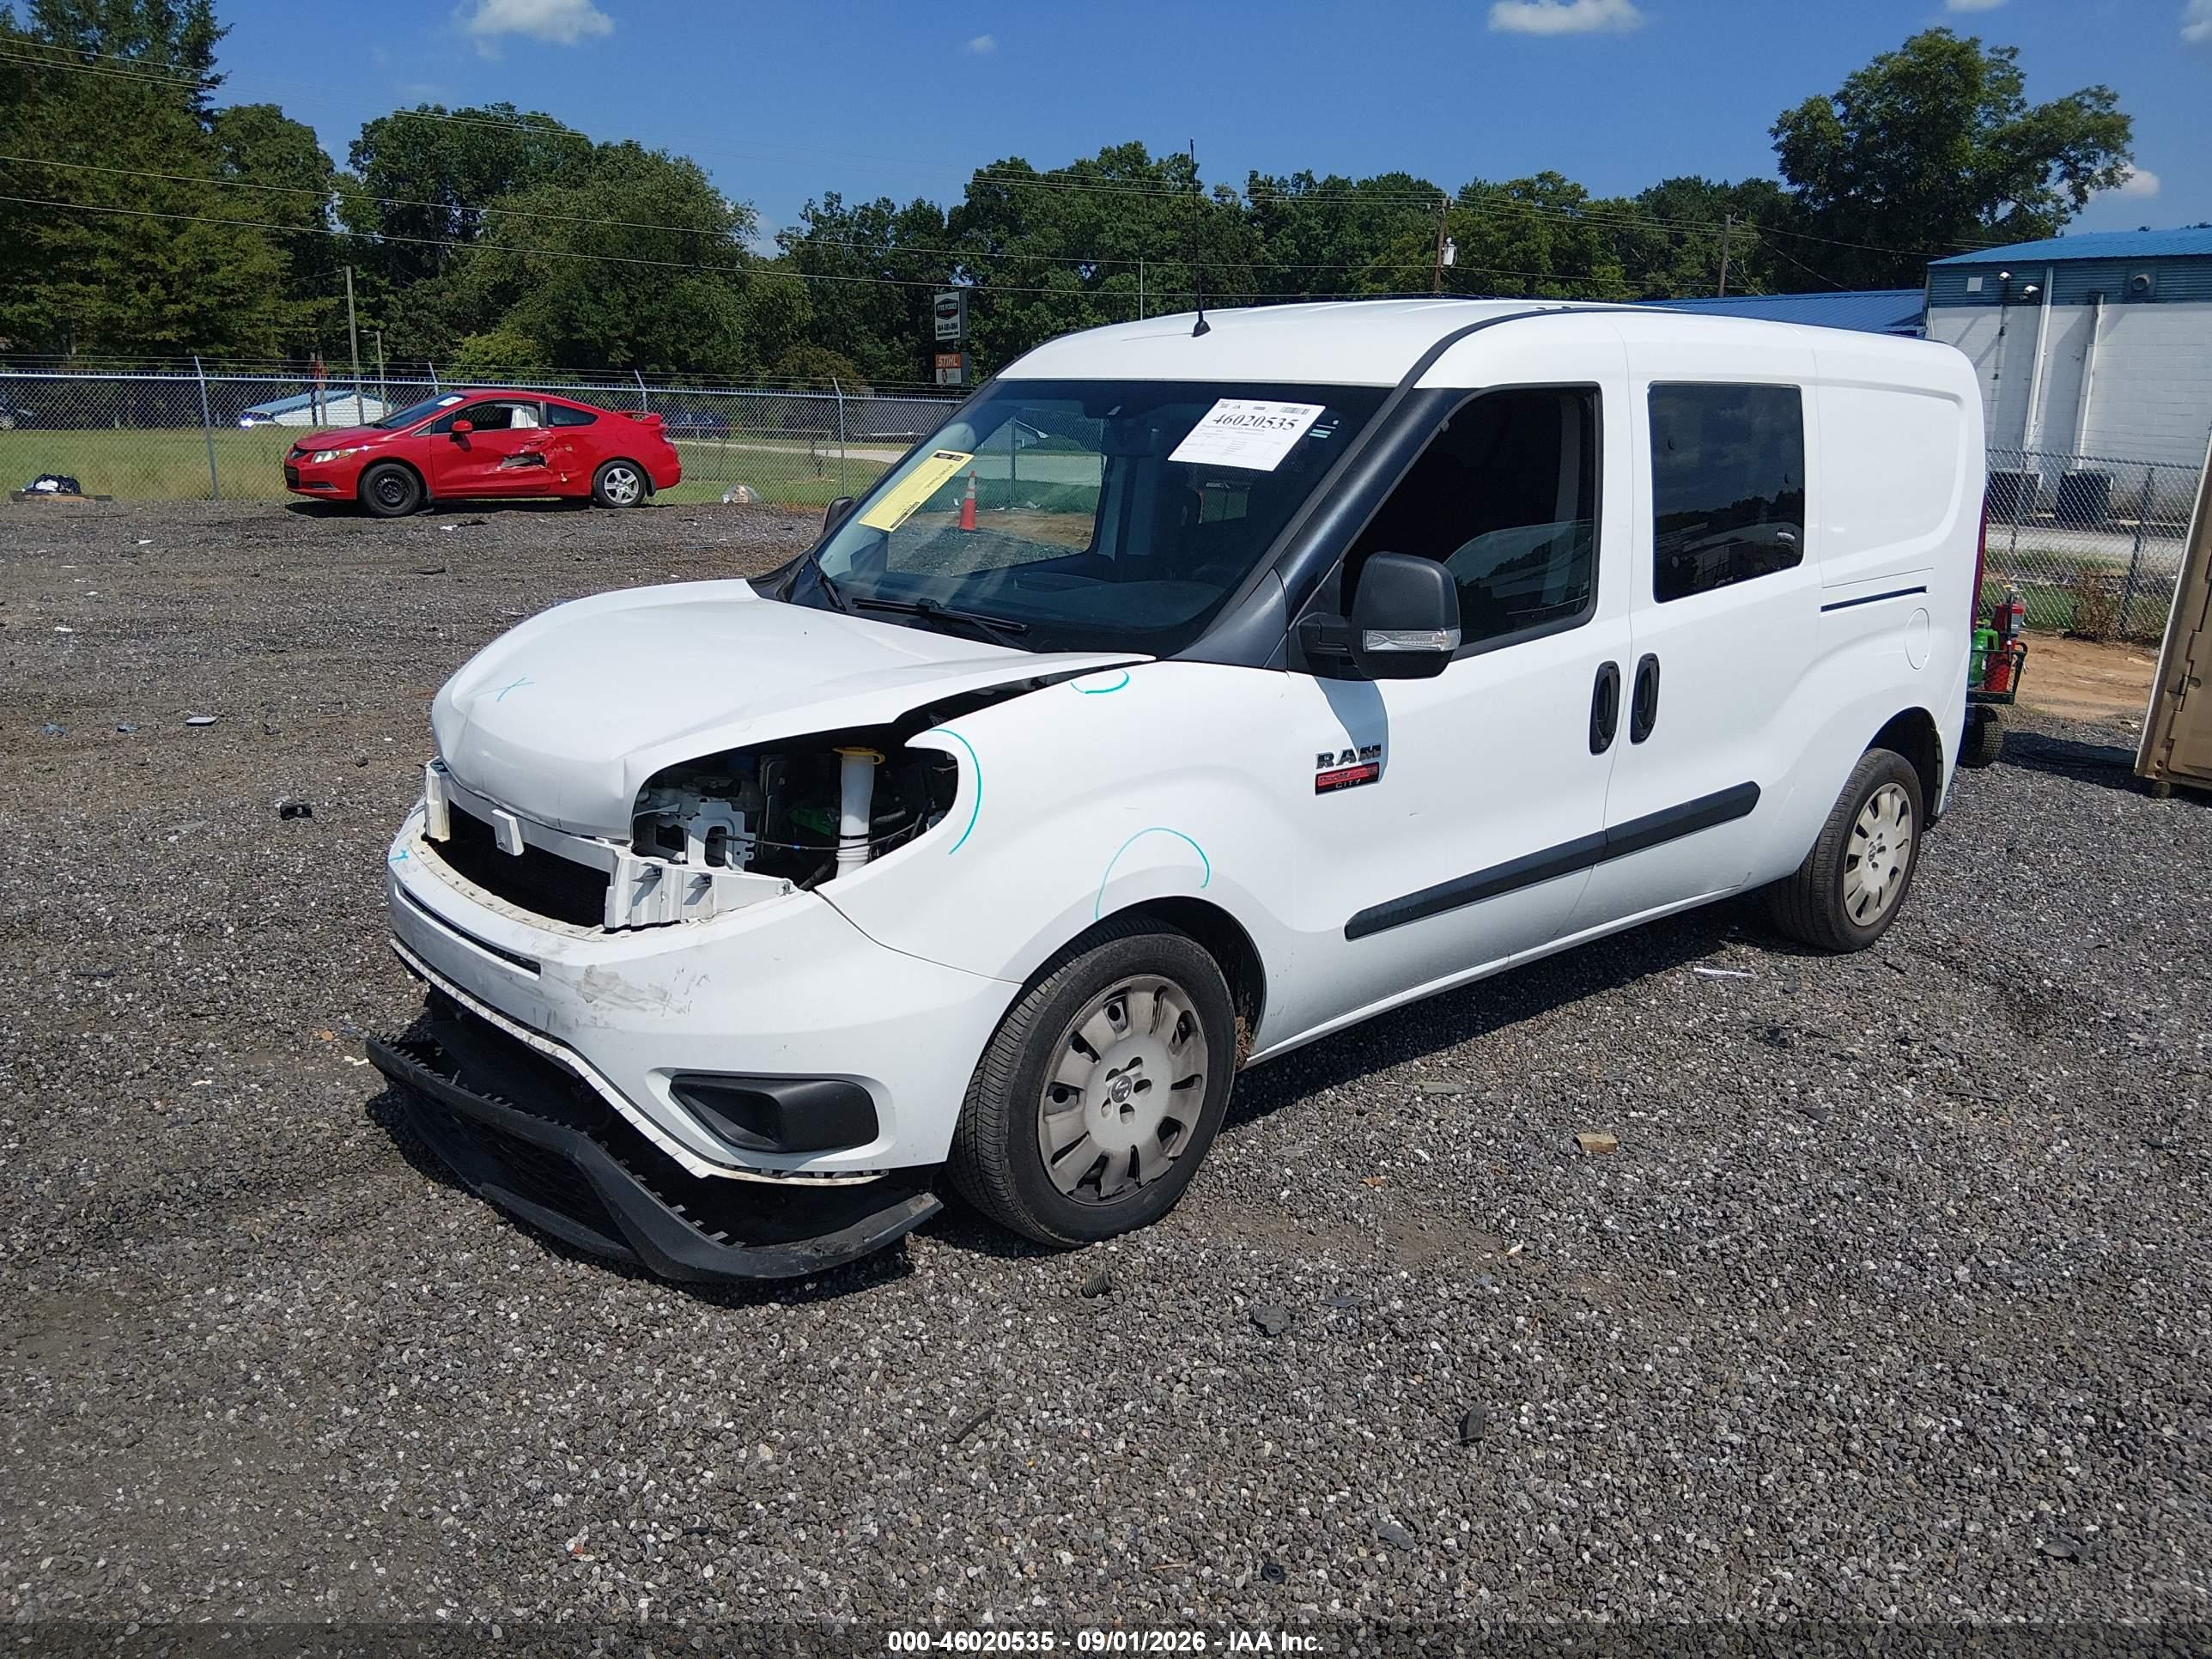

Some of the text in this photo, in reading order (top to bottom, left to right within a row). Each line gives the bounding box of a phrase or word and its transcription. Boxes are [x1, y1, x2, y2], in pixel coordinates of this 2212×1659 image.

[938, 356, 958, 367] STIHL
[1212, 413, 1299, 431] 46020535
[1316, 744, 1382, 769] RAM
[1335, 778, 1361, 788] CITY
